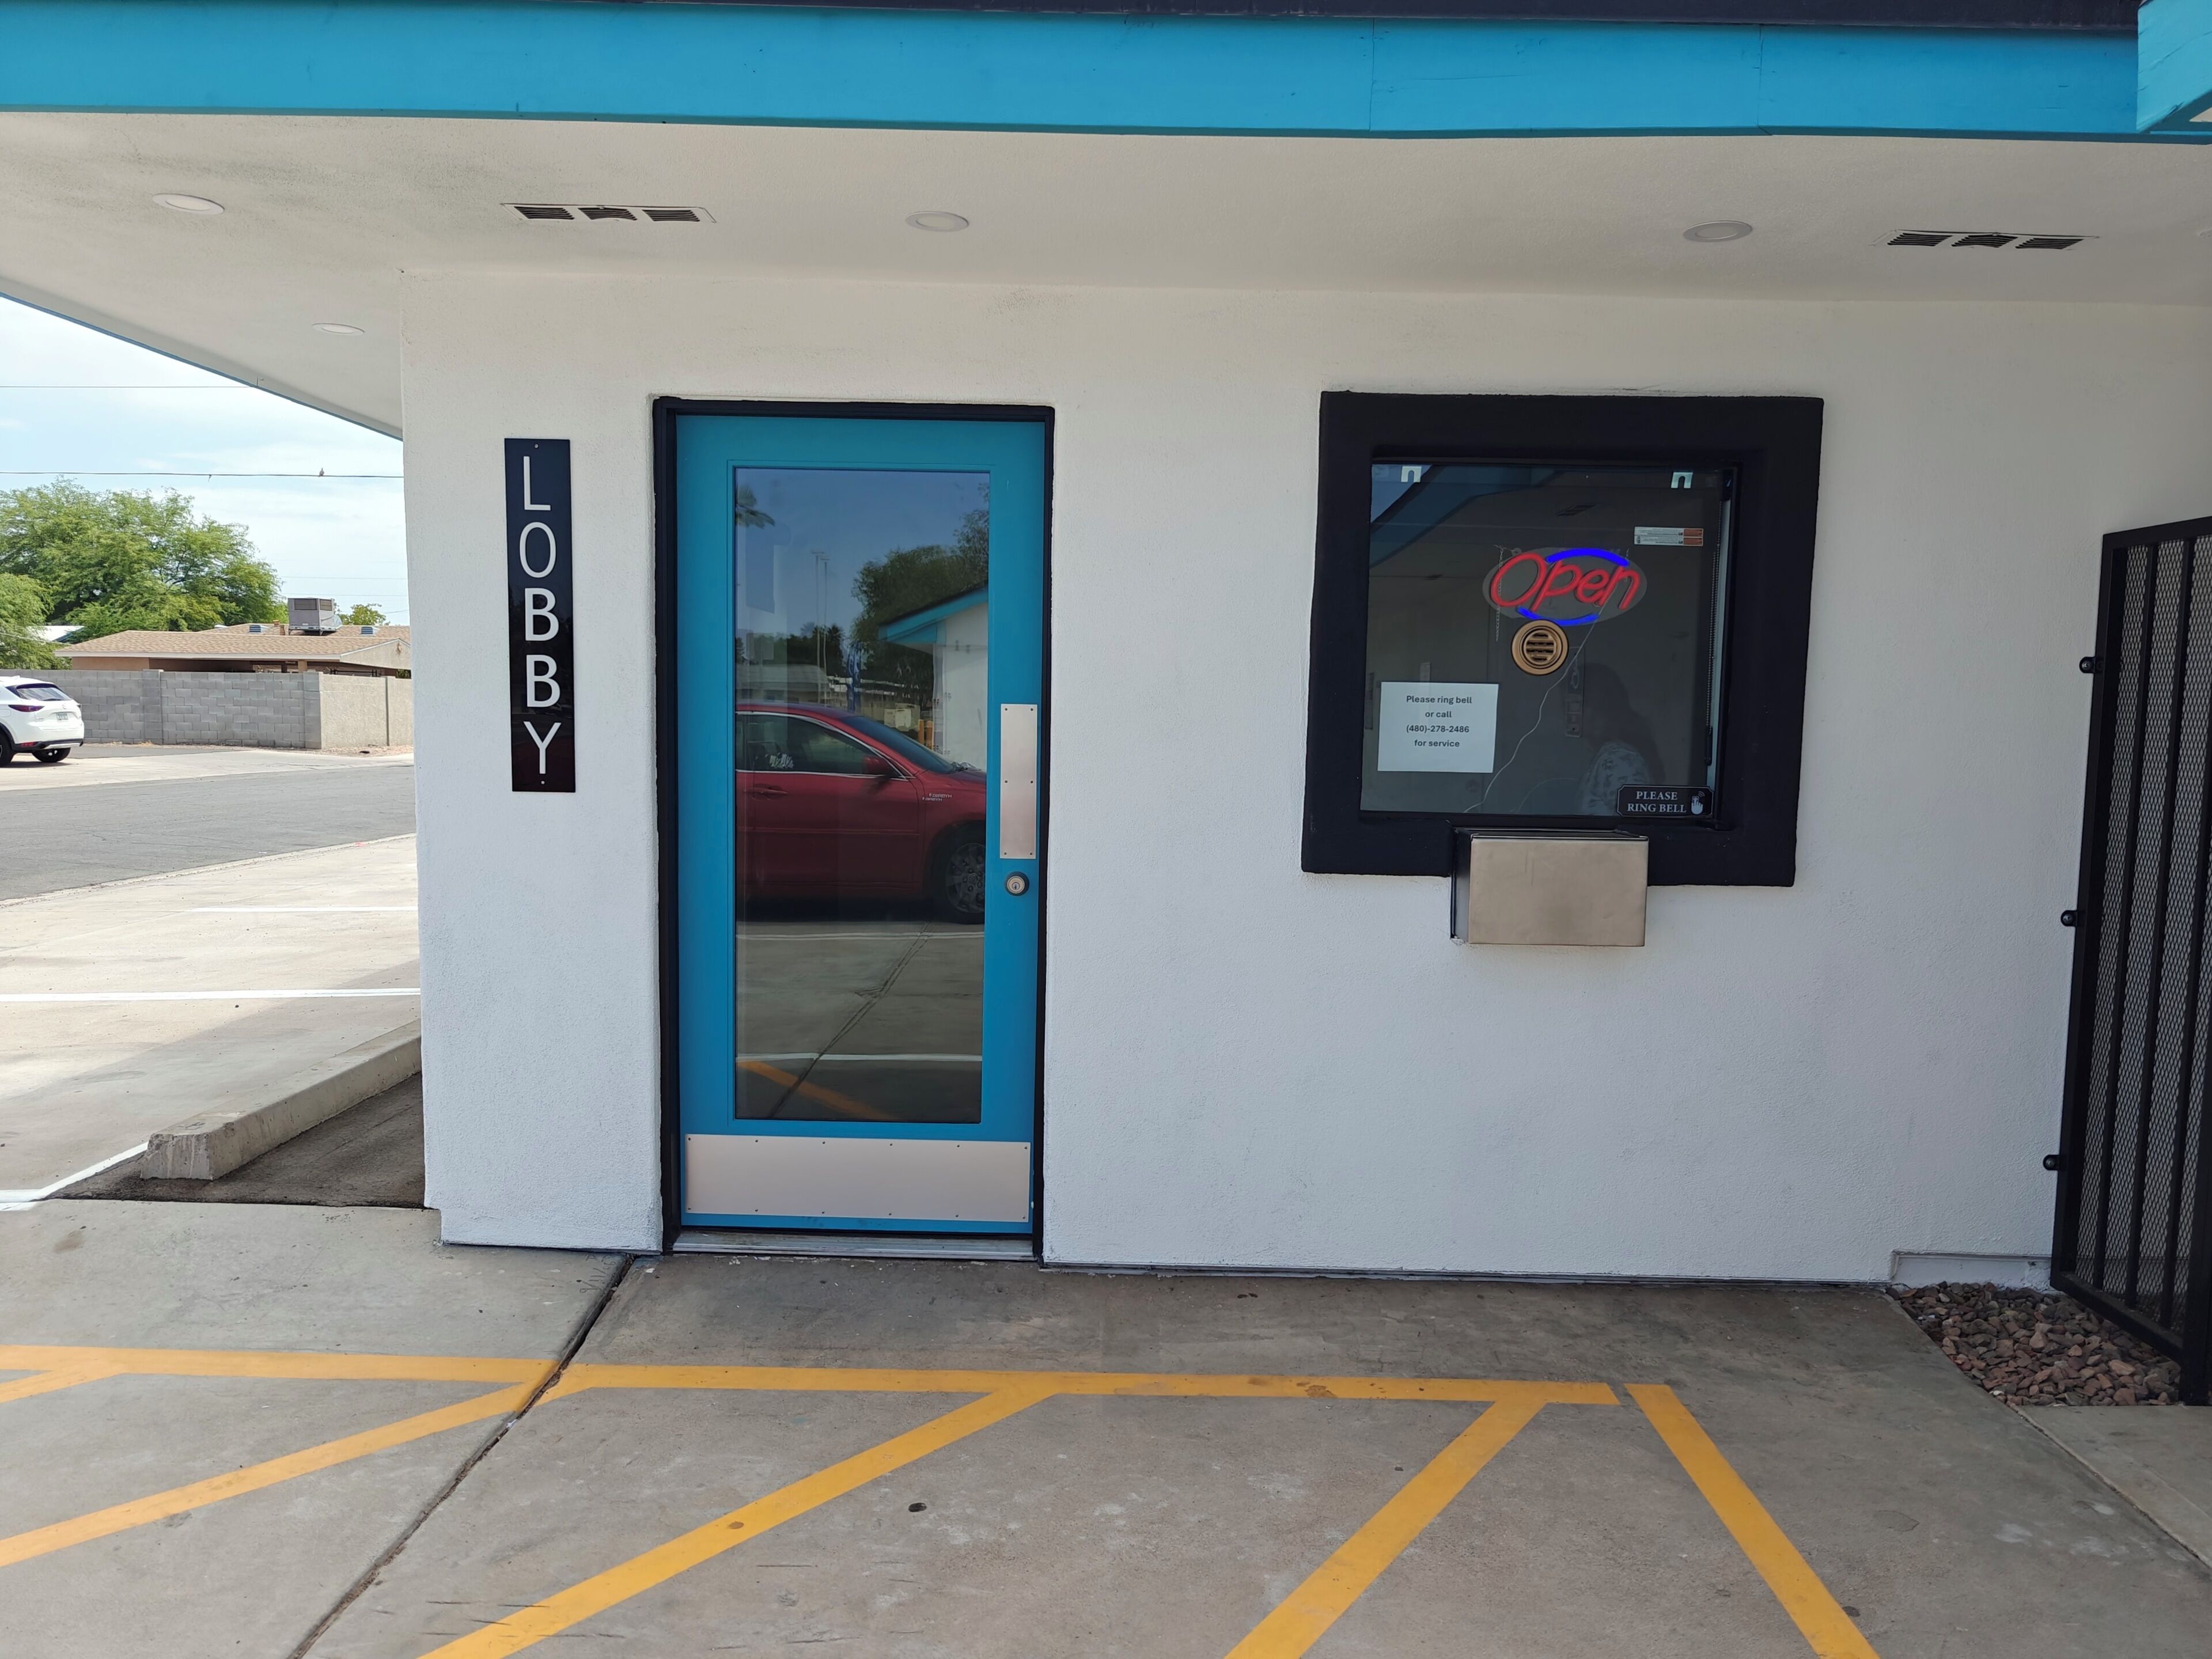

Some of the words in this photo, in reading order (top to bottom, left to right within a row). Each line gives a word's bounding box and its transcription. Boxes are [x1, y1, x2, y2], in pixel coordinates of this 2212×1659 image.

[1490, 552, 1641, 612] Open
[519, 456, 562, 774] LOBBY
[1406, 695, 1435, 703] Please
[1437, 696, 1454, 705] ring
[1406, 725, 1469, 734] (480)-278-2486
[1635, 791, 1678, 800] PLEASE
[1627, 803, 1656, 812] RING
[1659, 804, 1687, 813] BELL
